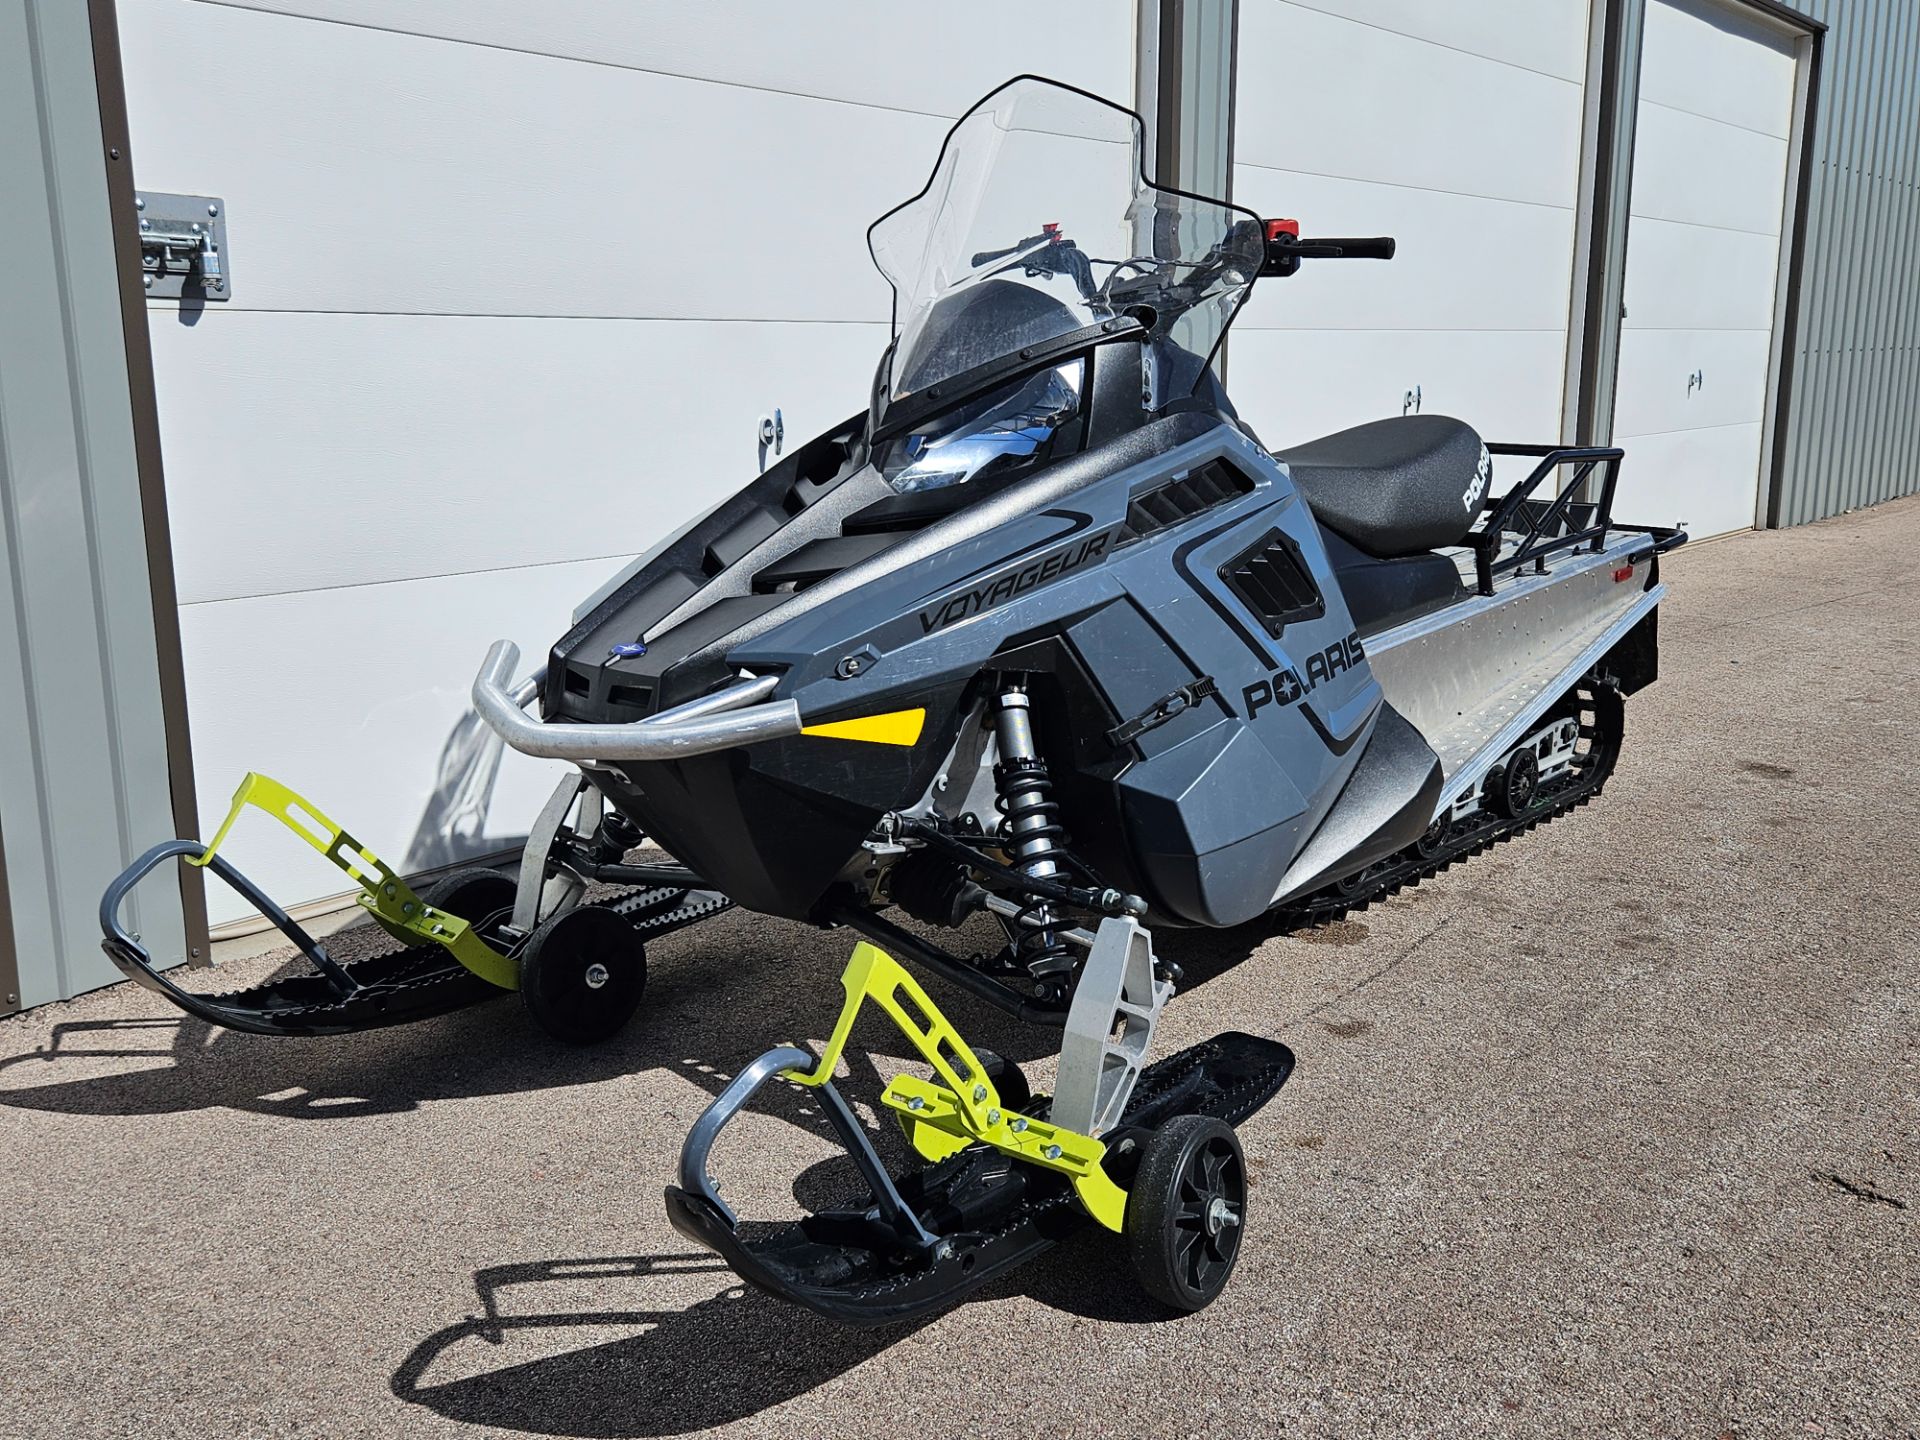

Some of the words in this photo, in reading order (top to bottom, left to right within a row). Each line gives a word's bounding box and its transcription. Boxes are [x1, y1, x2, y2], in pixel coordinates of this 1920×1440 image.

[1462, 439, 1490, 513] POLAR
[918, 531, 1111, 634] VOYAGEUR
[1242, 630, 1365, 721] POLARIS
